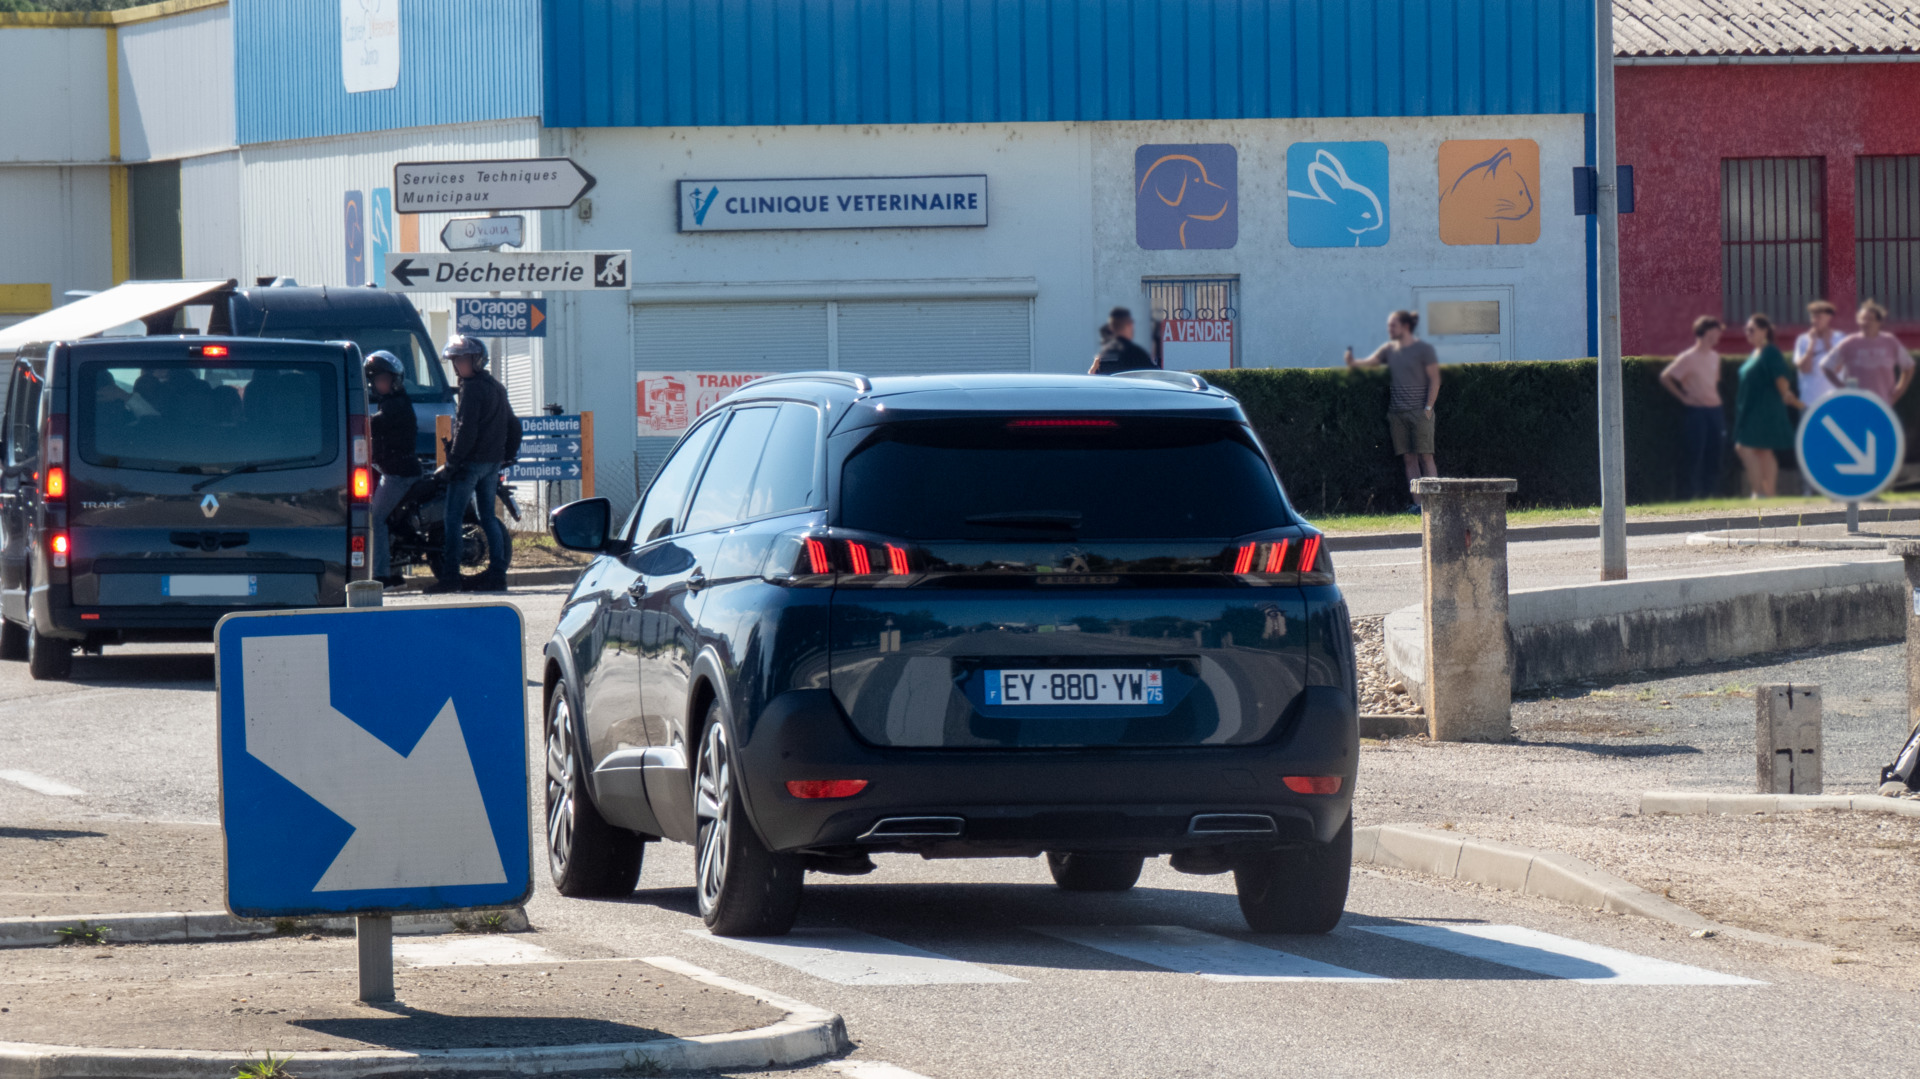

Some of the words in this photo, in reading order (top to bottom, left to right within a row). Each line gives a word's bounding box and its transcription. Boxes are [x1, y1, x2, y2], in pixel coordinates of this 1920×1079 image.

[403, 172, 465, 185] Services
[477, 170, 558, 184] Techniques
[403, 190, 490, 204] Municipaux
[725, 196, 829, 214] CLINIQUE
[837, 193, 978, 212] VETERINAIRE
[436, 261, 583, 283] Déchetterie
[461, 299, 527, 318] l'Orange
[481, 315, 527, 330] bleue
[1163, 321, 1173, 341] A
[1177, 321, 1231, 341] VENDRE
[522, 418, 579, 431] Déchèterie
[520, 442, 558, 455] Municipaux
[513, 464, 562, 478] Pompiers
[81, 501, 126, 509] TRAFIC
[990, 691, 996, 699] F
[1148, 688, 1163, 701] 75
